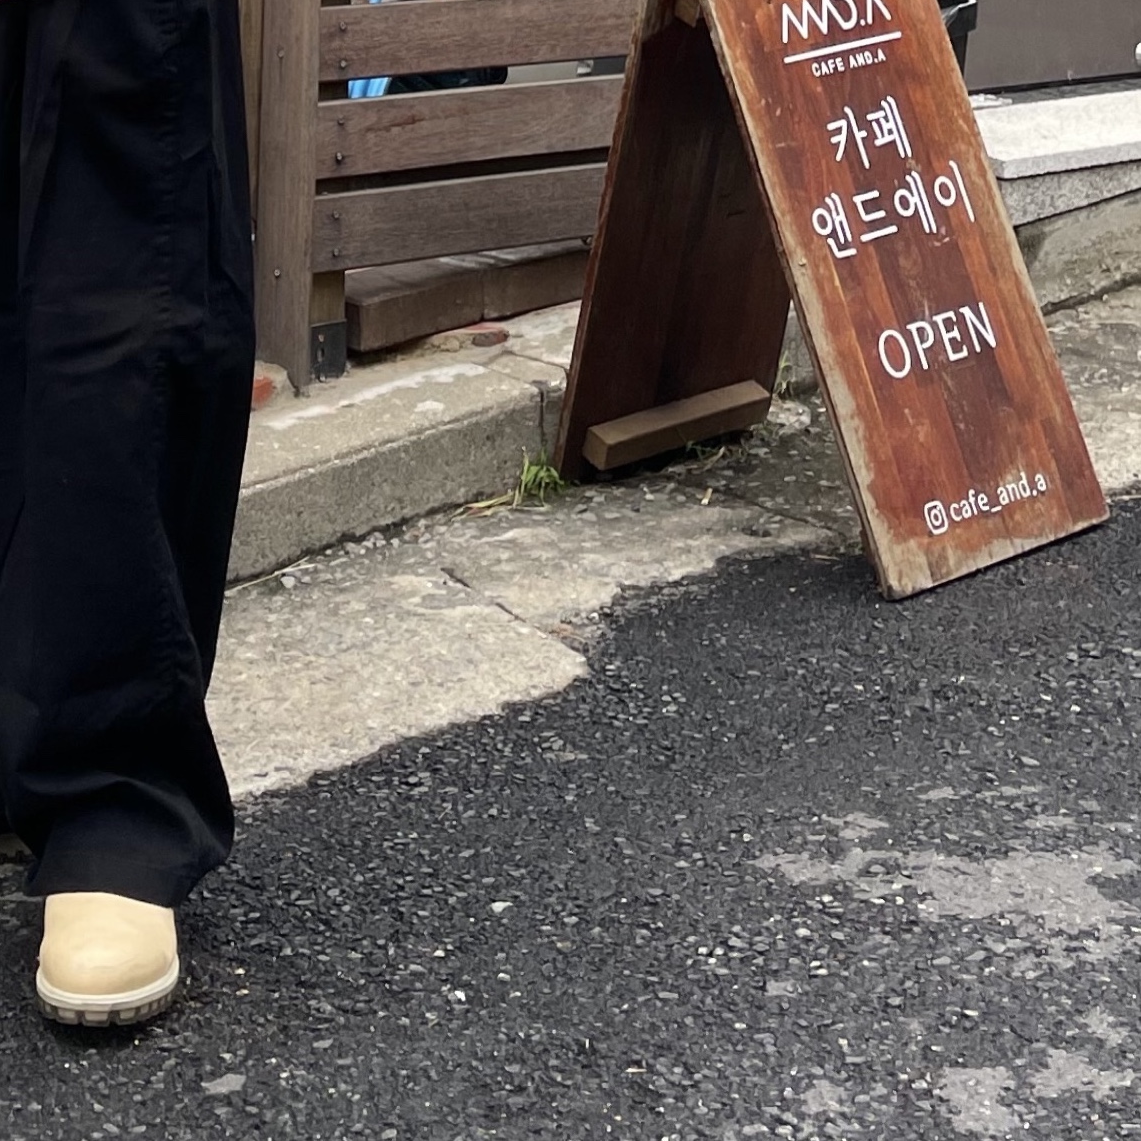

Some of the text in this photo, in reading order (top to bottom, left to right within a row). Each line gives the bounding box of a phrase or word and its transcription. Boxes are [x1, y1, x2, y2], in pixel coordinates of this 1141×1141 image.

[811, 54, 846, 77] CAFE
[826, 95, 913, 170] 카페
[811, 160, 975, 259] 앤드에이
[878, 301, 997, 379] OPEN
